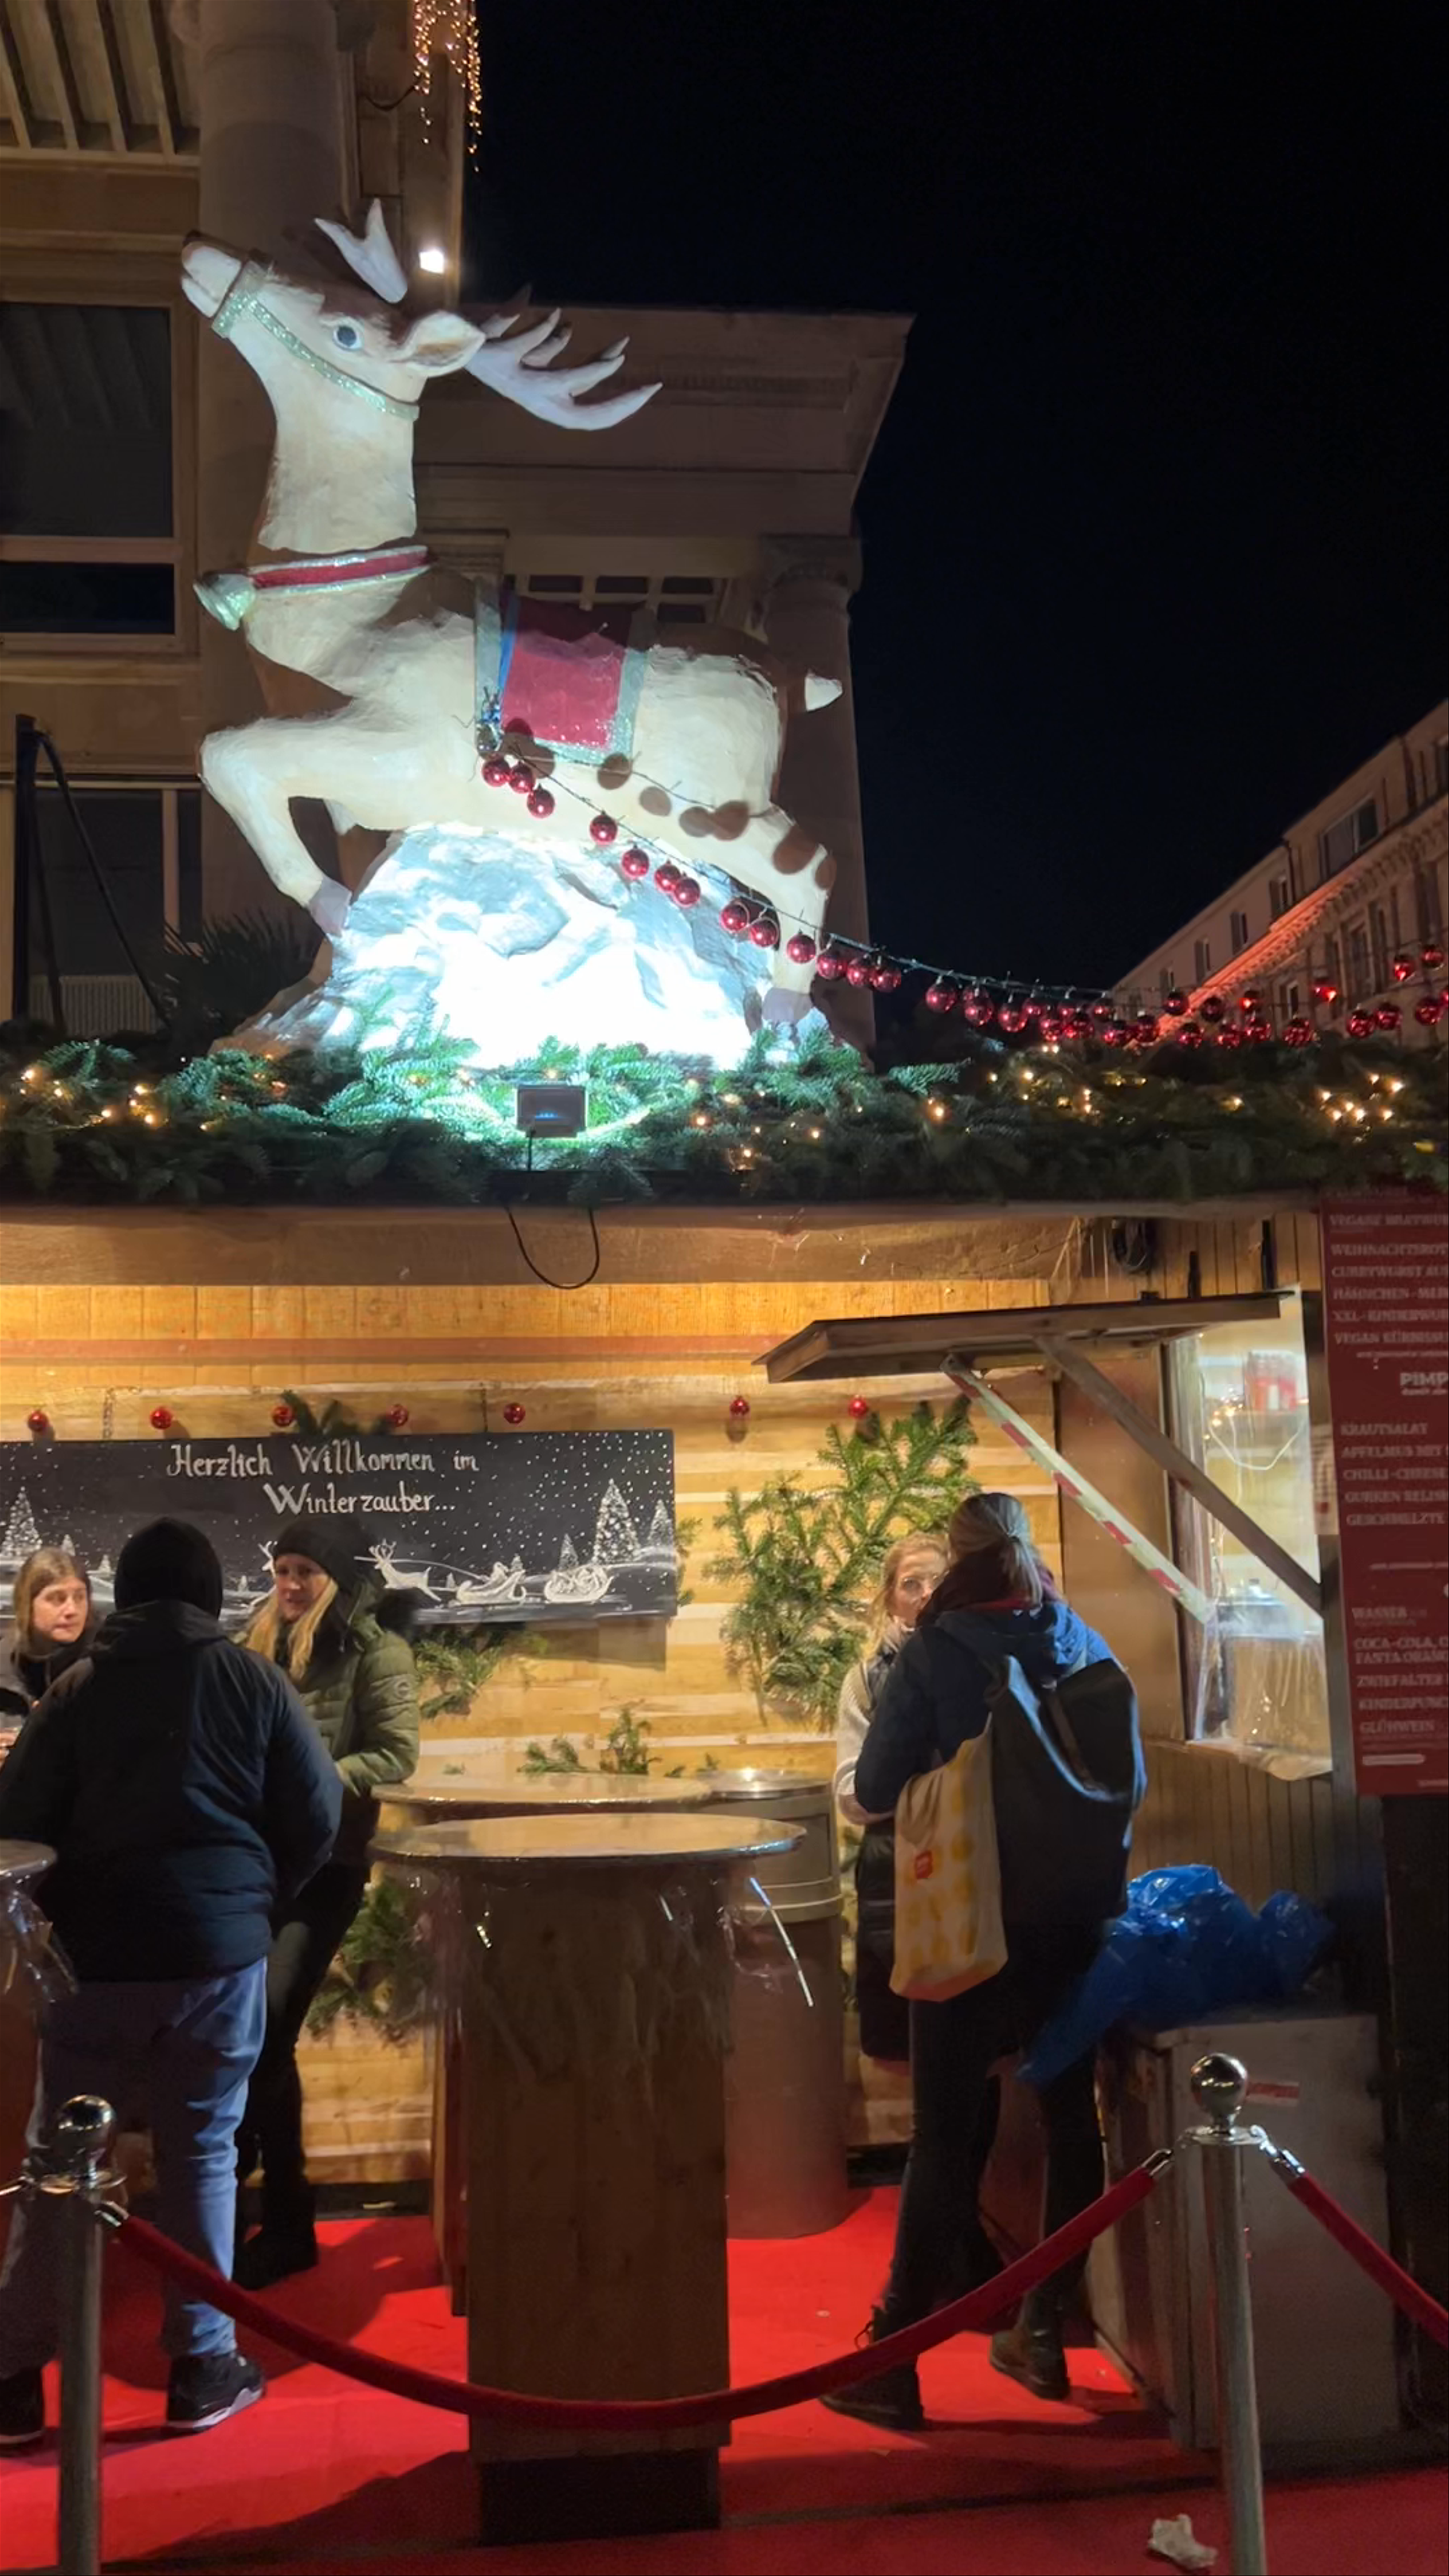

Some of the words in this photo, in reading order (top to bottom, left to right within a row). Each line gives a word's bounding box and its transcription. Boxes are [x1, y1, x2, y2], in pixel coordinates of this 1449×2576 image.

[1400, 1372, 1449, 1386] PIMP
[1341, 1423, 1428, 1435] KRAUTSALAT
[167, 1444, 273, 1477] Herzlich
[292, 1439, 435, 1474] Willkommen
[453, 1450, 480, 1471] im
[1355, 1652, 1401, 1664] FANTA
[1360, 1718, 1435, 1733] GLÜHWEIN
